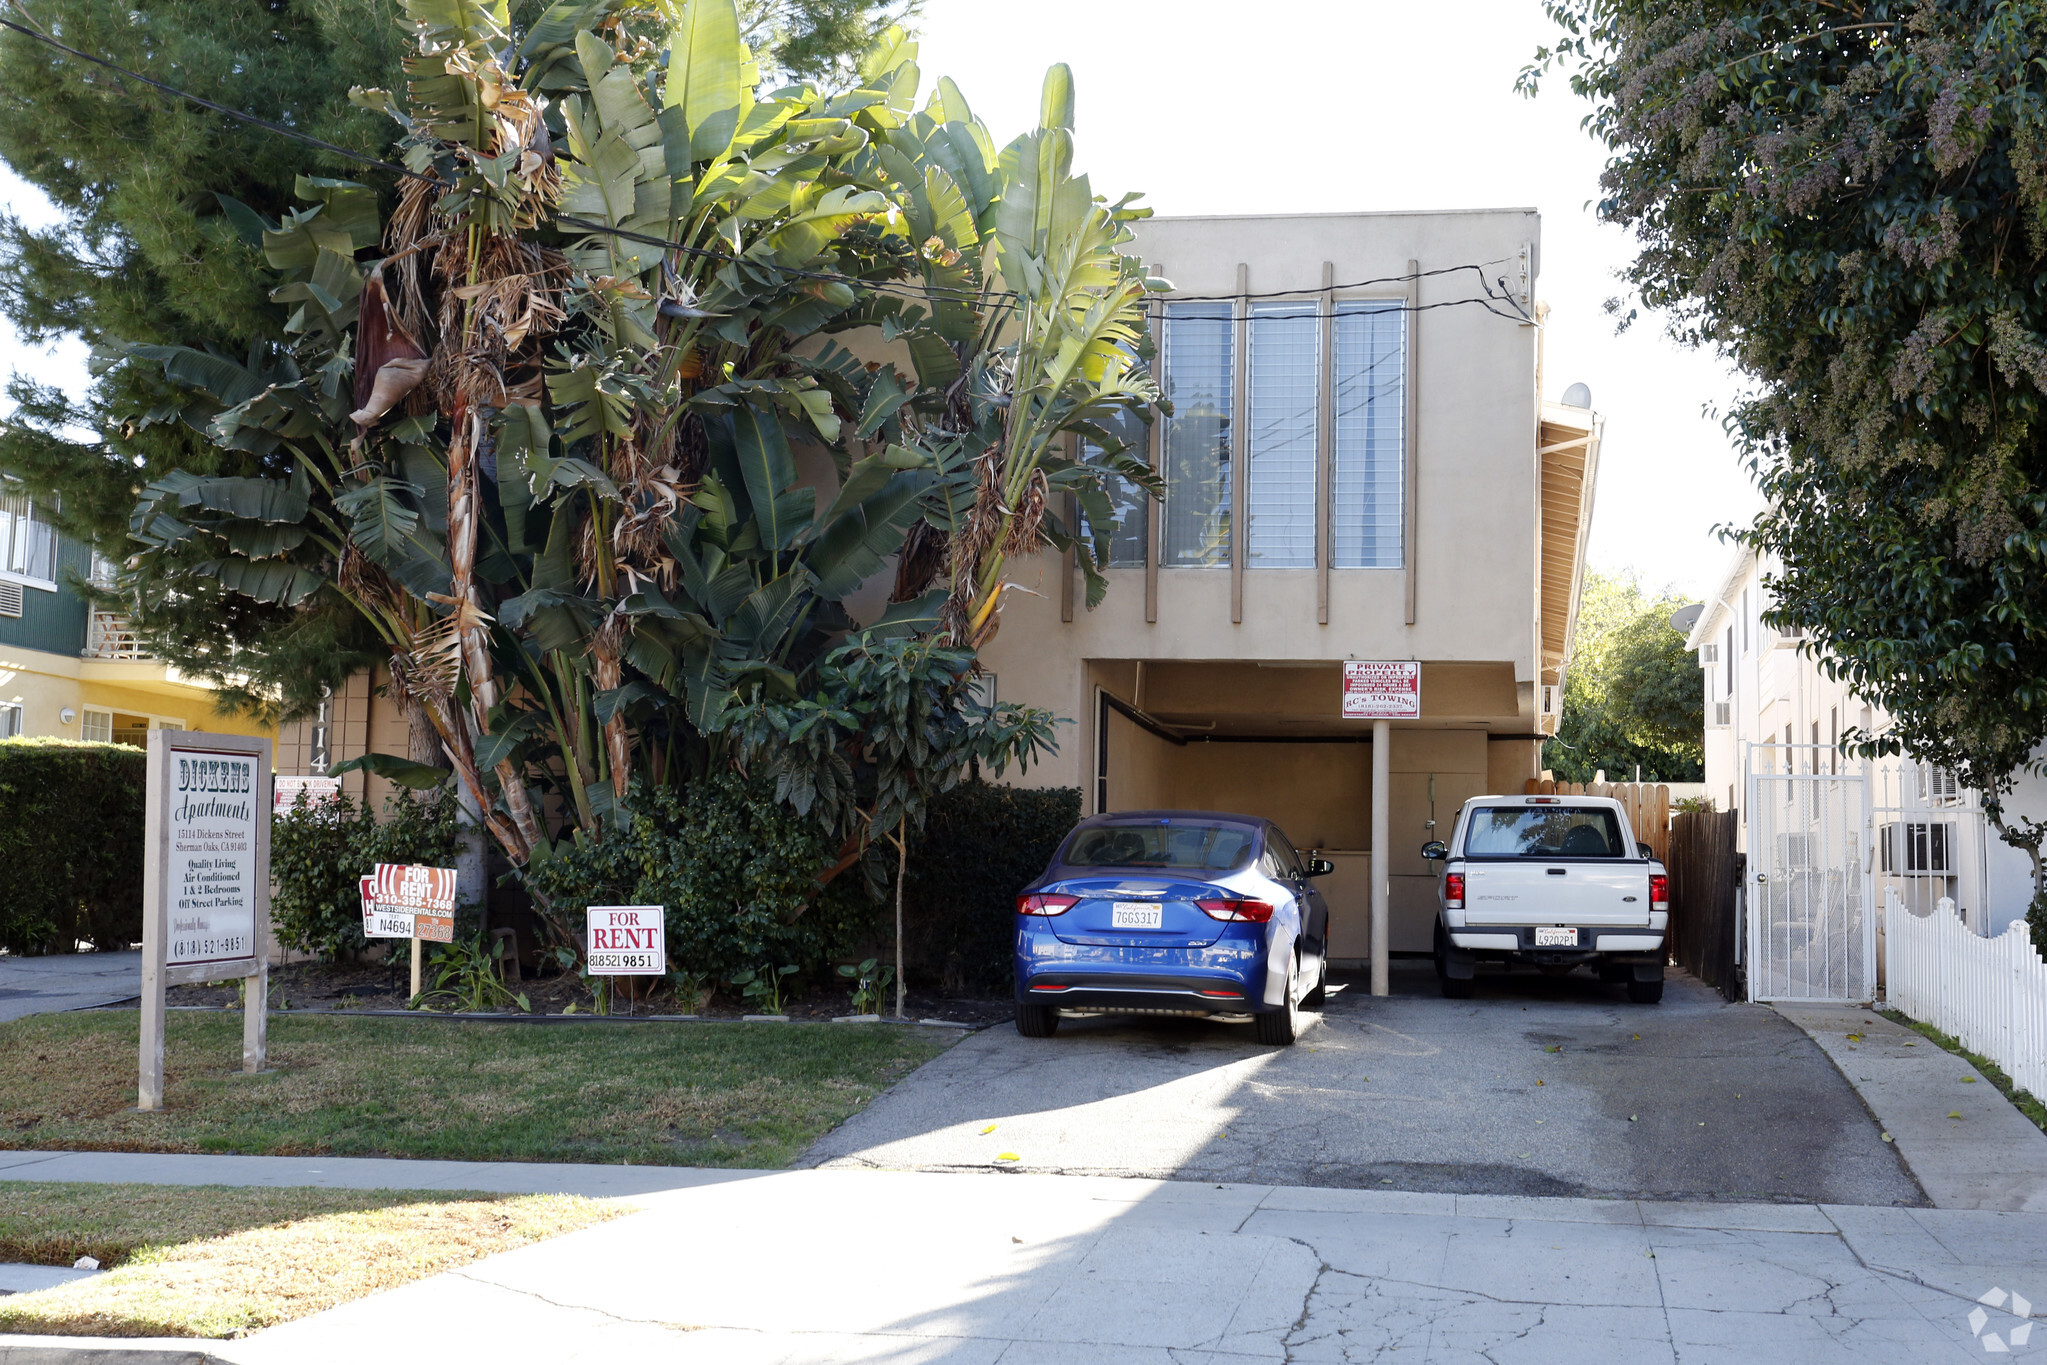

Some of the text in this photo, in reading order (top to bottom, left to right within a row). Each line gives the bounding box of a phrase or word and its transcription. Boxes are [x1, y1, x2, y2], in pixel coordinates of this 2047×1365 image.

[1371, 694, 1415, 708] TOWING
[178, 759, 250, 793] DICKENS
[174, 794, 250, 825] Apartments
[178, 829, 245, 839] 15114 Dickens Street
[175, 842, 202, 852] Sherman
[203, 842, 220, 853] Oaks,
[220, 842, 231, 852] CA
[188, 859, 236, 872] Quality Living
[184, 872, 240, 883] Air Conditioned
[405, 867, 430, 883] FOR
[189, 886, 196, 895] &
[198, 885, 203, 895] 2
[204, 885, 241, 895] Bedrooms
[400, 881, 433, 898] RENT
[179, 897, 244, 909] Off Street Parking
[376, 893, 453, 910] 310-395-7368
[375, 904, 452, 918] WESTSIDERENTALS.COM
[1116, 911, 1159, 924] 7GGS317
[609, 912, 640, 926] FOR
[380, 919, 412, 935] N4694
[418, 924, 451, 940] 27368
[593, 928, 658, 949] RENT
[174, 936, 246, 958] (818) 521-9851
